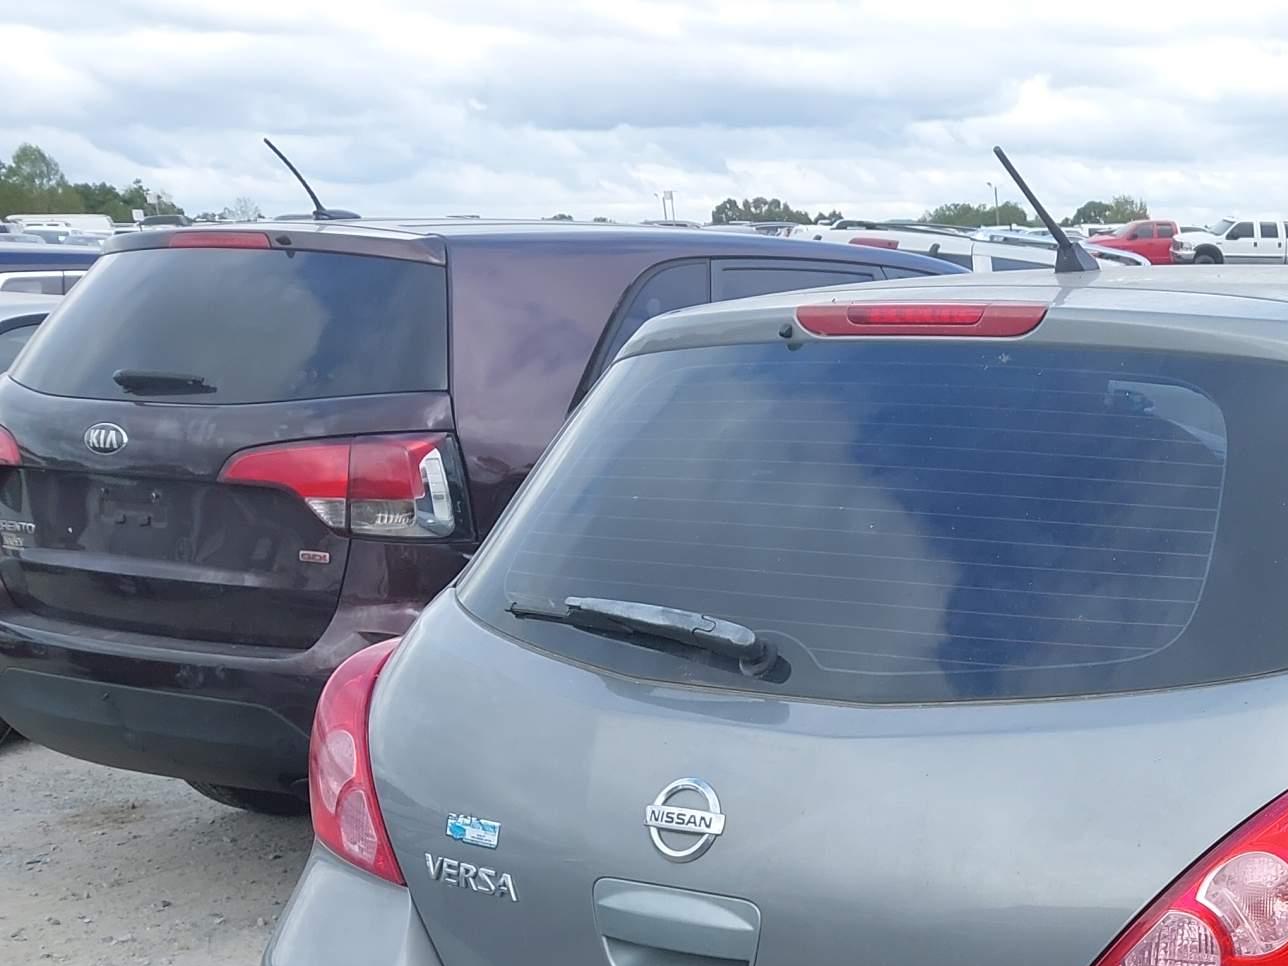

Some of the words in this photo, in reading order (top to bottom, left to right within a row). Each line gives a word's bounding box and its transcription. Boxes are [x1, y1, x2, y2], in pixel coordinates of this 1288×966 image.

[89, 429, 118, 449] KIA
[649, 809, 713, 829] NISSAN
[425, 853, 517, 902] VERSA
